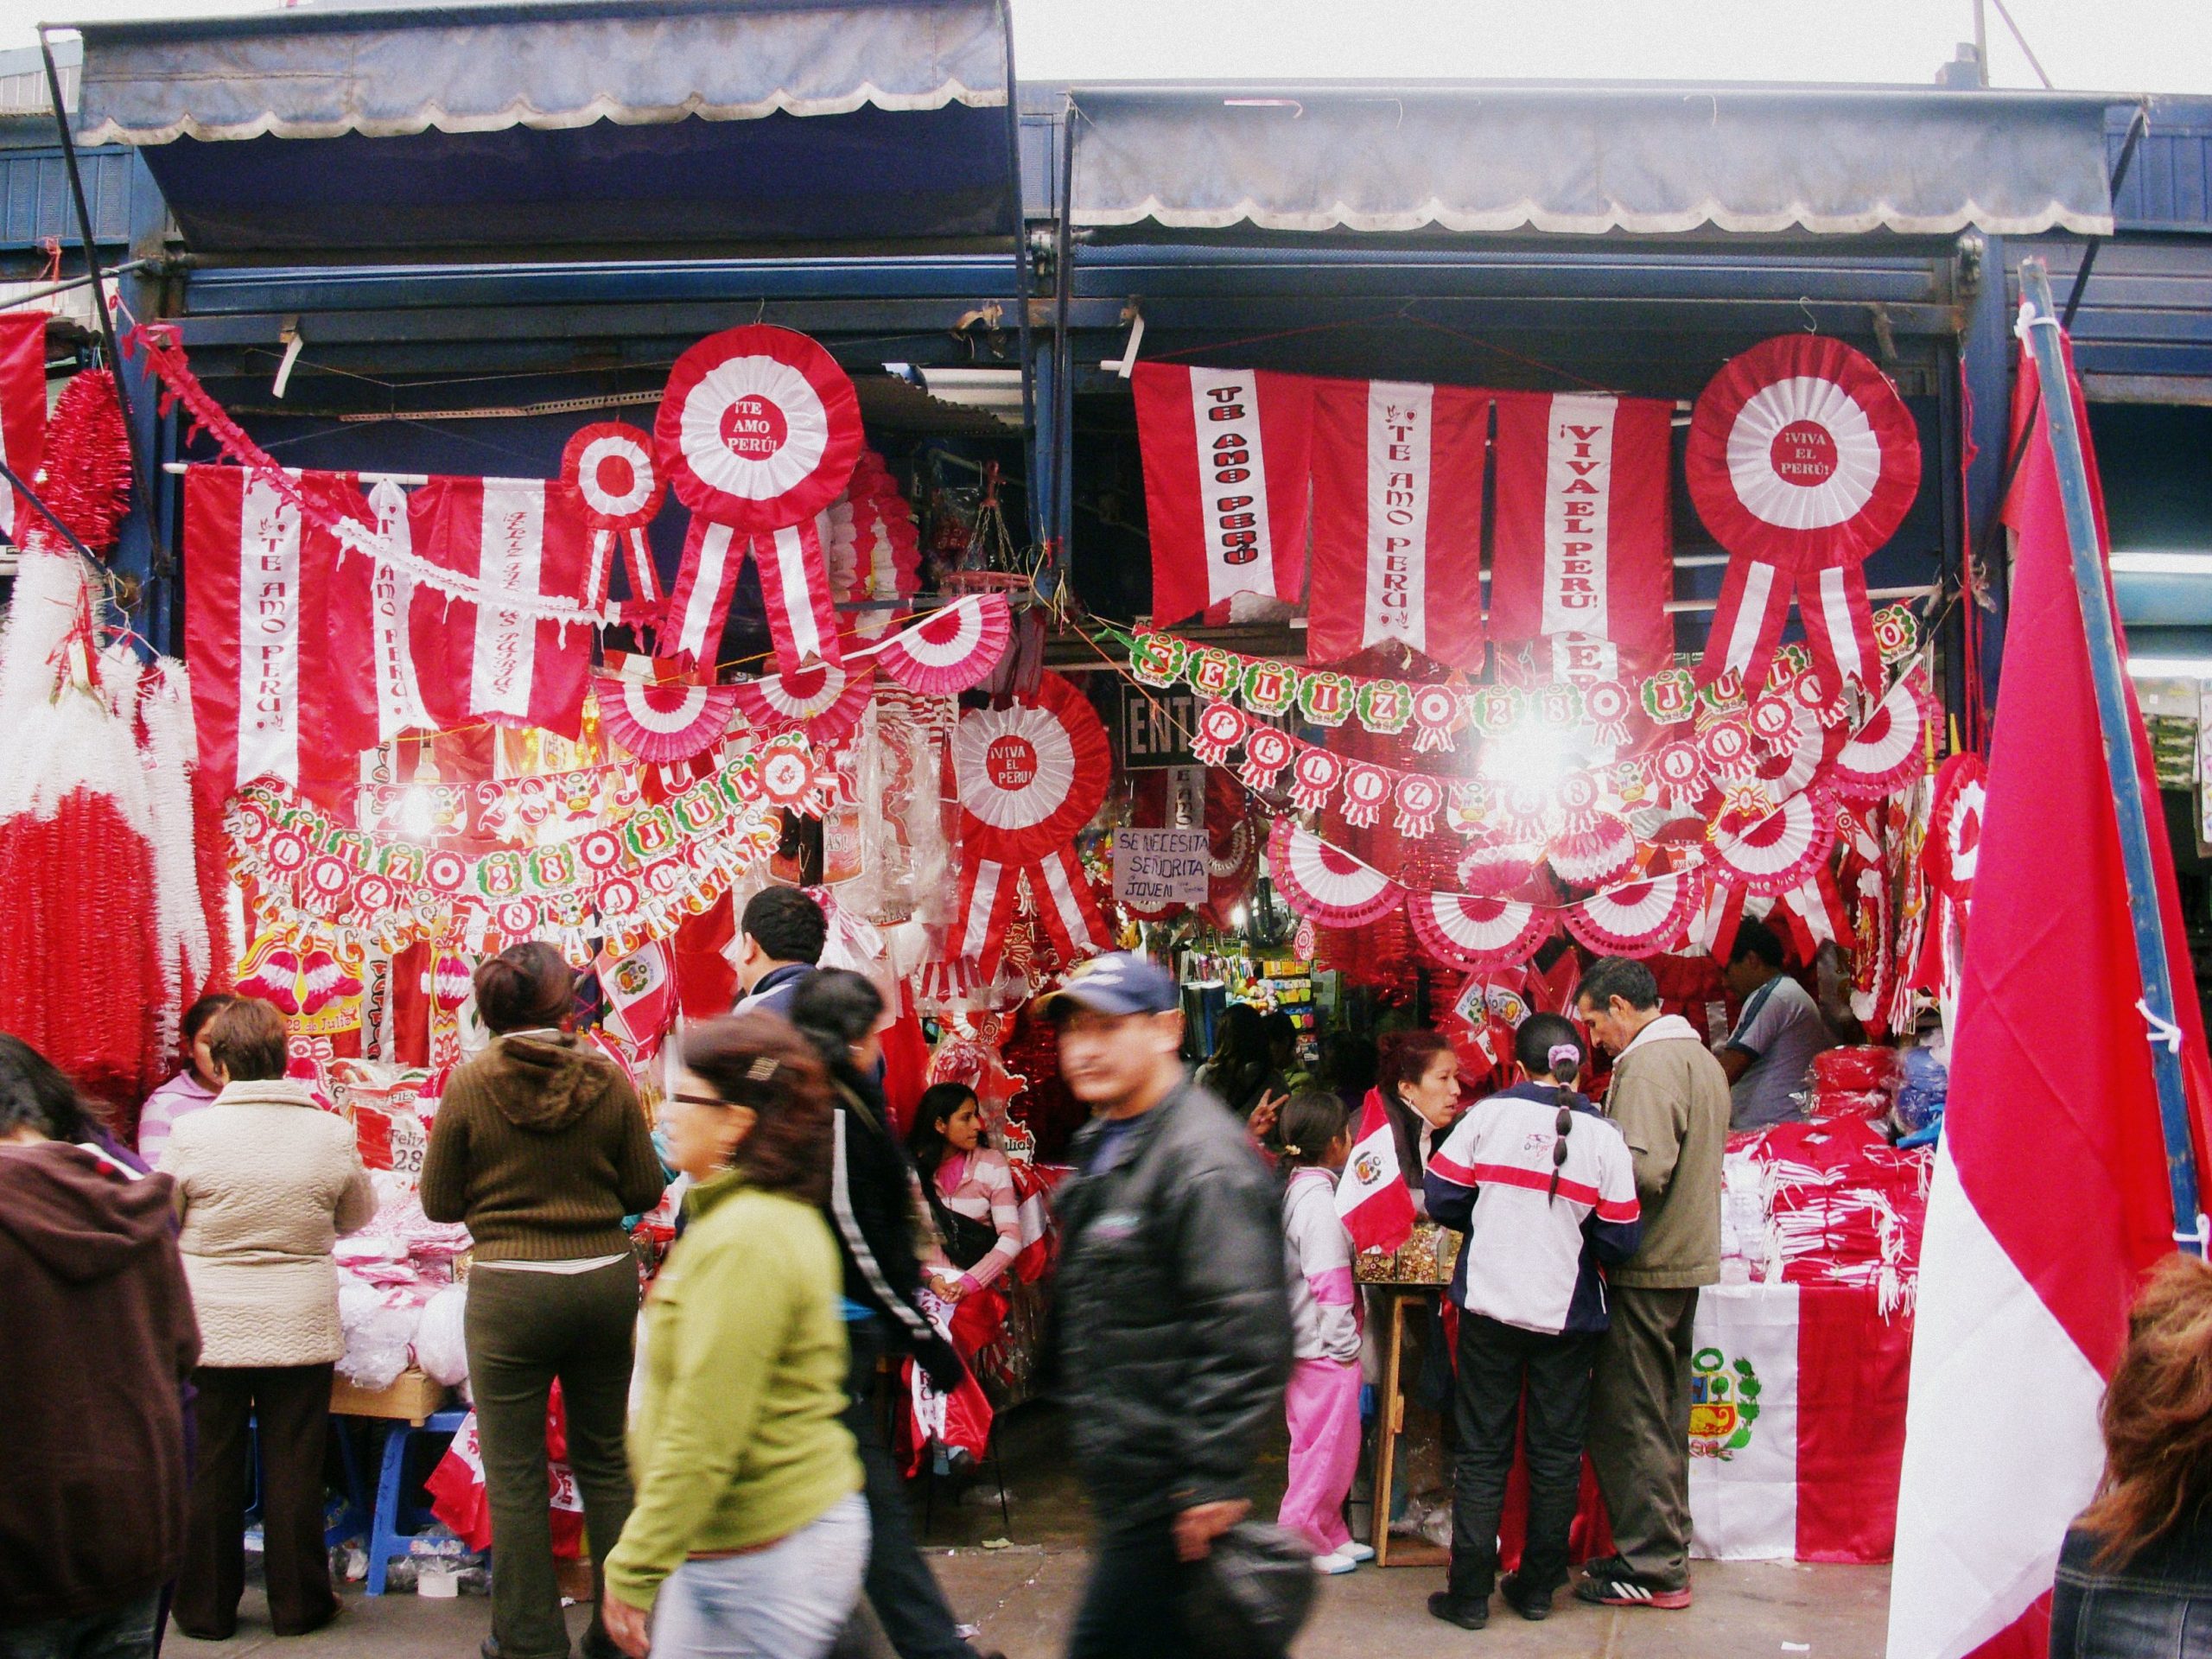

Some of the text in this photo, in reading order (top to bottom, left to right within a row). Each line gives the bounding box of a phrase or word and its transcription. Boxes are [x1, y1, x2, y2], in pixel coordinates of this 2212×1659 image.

[734, 400, 762, 416] ¡TE
[1207, 386, 1245, 421] TE
[733, 419, 771, 434] AMO
[727, 435, 777, 453] PERÚ!
[1388, 425, 1413, 461] TE
[1796, 448, 1817, 460] EL
[1212, 433, 1250, 484] AMO
[1386, 472, 1414, 525] AMO
[1562, 501, 1594, 533] EL
[261, 537, 283, 571] TE
[377, 563, 396, 617] AMO
[259, 582, 285, 633] AMO
[990, 746, 1026, 760] ¡VIVA
[1006, 759, 1019, 770] EL
[1211, 715, 1428, 807] FELIZ
[1120, 833, 1210, 853] SE NECESITA
[1125, 882, 1173, 898] JOVEN
[286, 1019, 301, 1031] 28
[321, 1014, 352, 1031] Julio
[394, 1149, 423, 1173] 28
